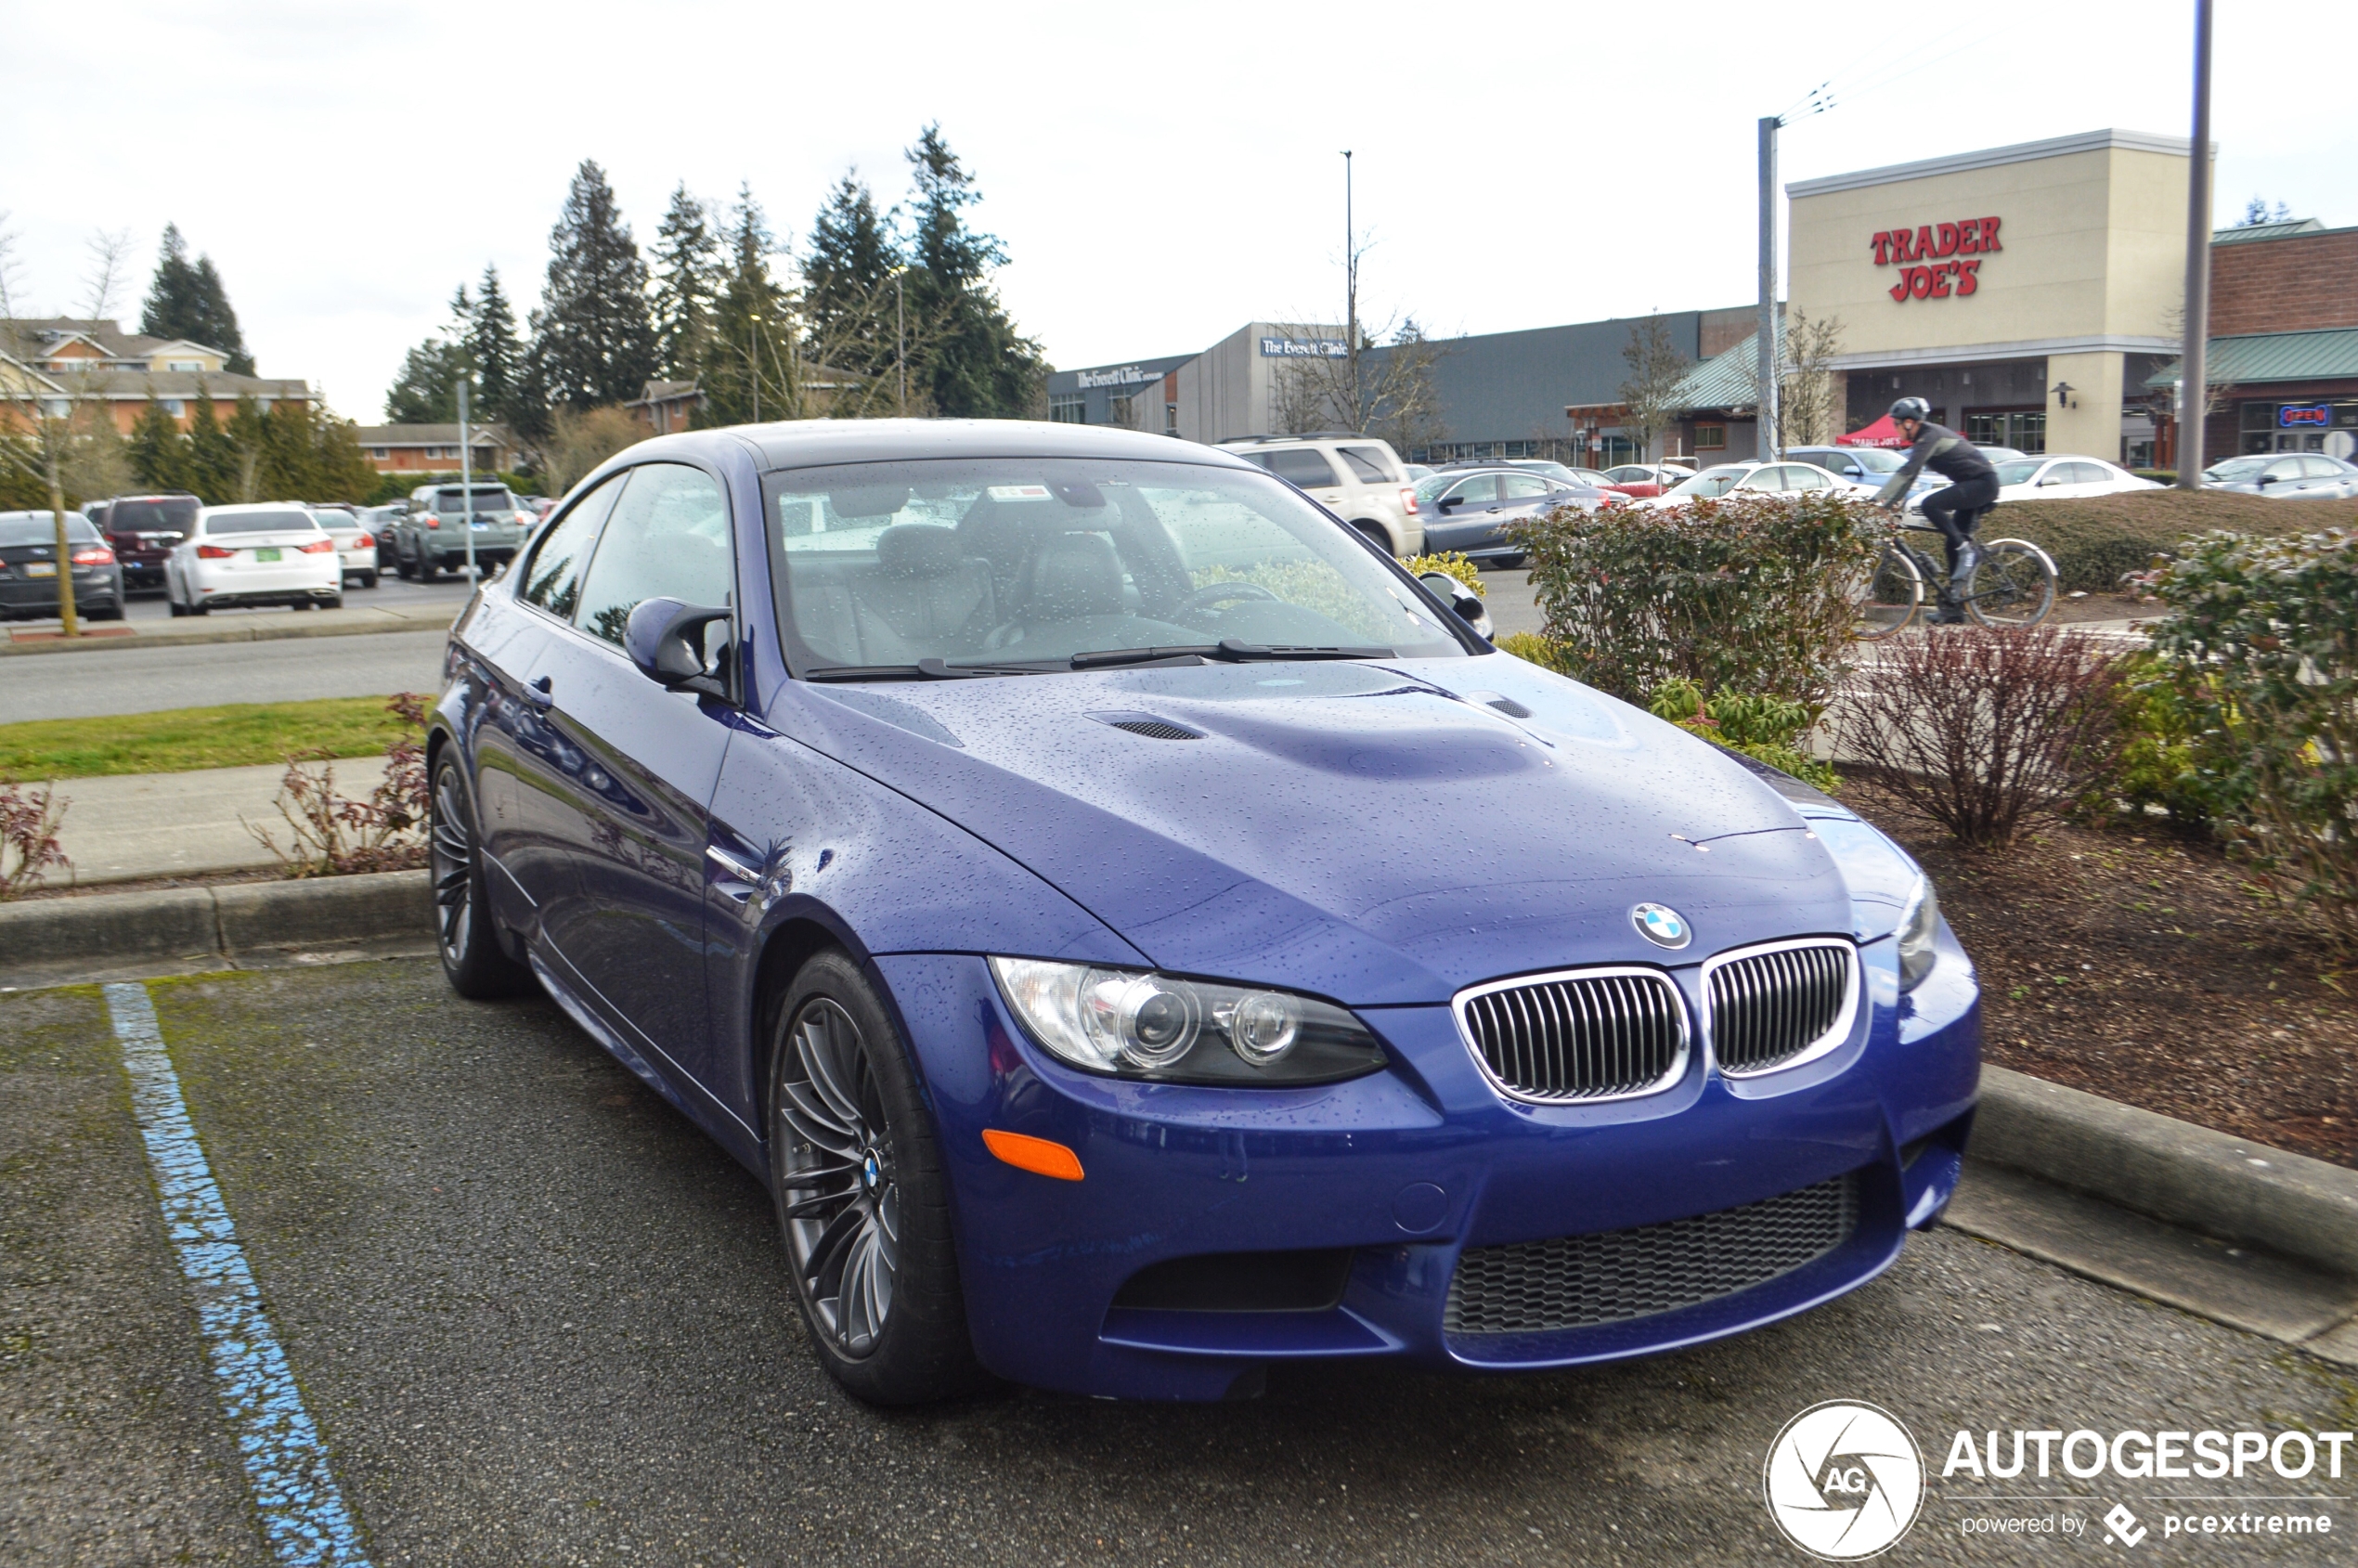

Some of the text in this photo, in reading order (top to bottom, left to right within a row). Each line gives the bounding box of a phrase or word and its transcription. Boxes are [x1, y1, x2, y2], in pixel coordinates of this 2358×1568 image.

[1870, 215, 2003, 266] TRADER
[1888, 259, 1983, 303] JOE'S
[1263, 340, 1349, 356] The Everett Clinic
[2285, 408, 2326, 422] OPEN
[1850, 436, 1901, 447] TRADER JOE'S
